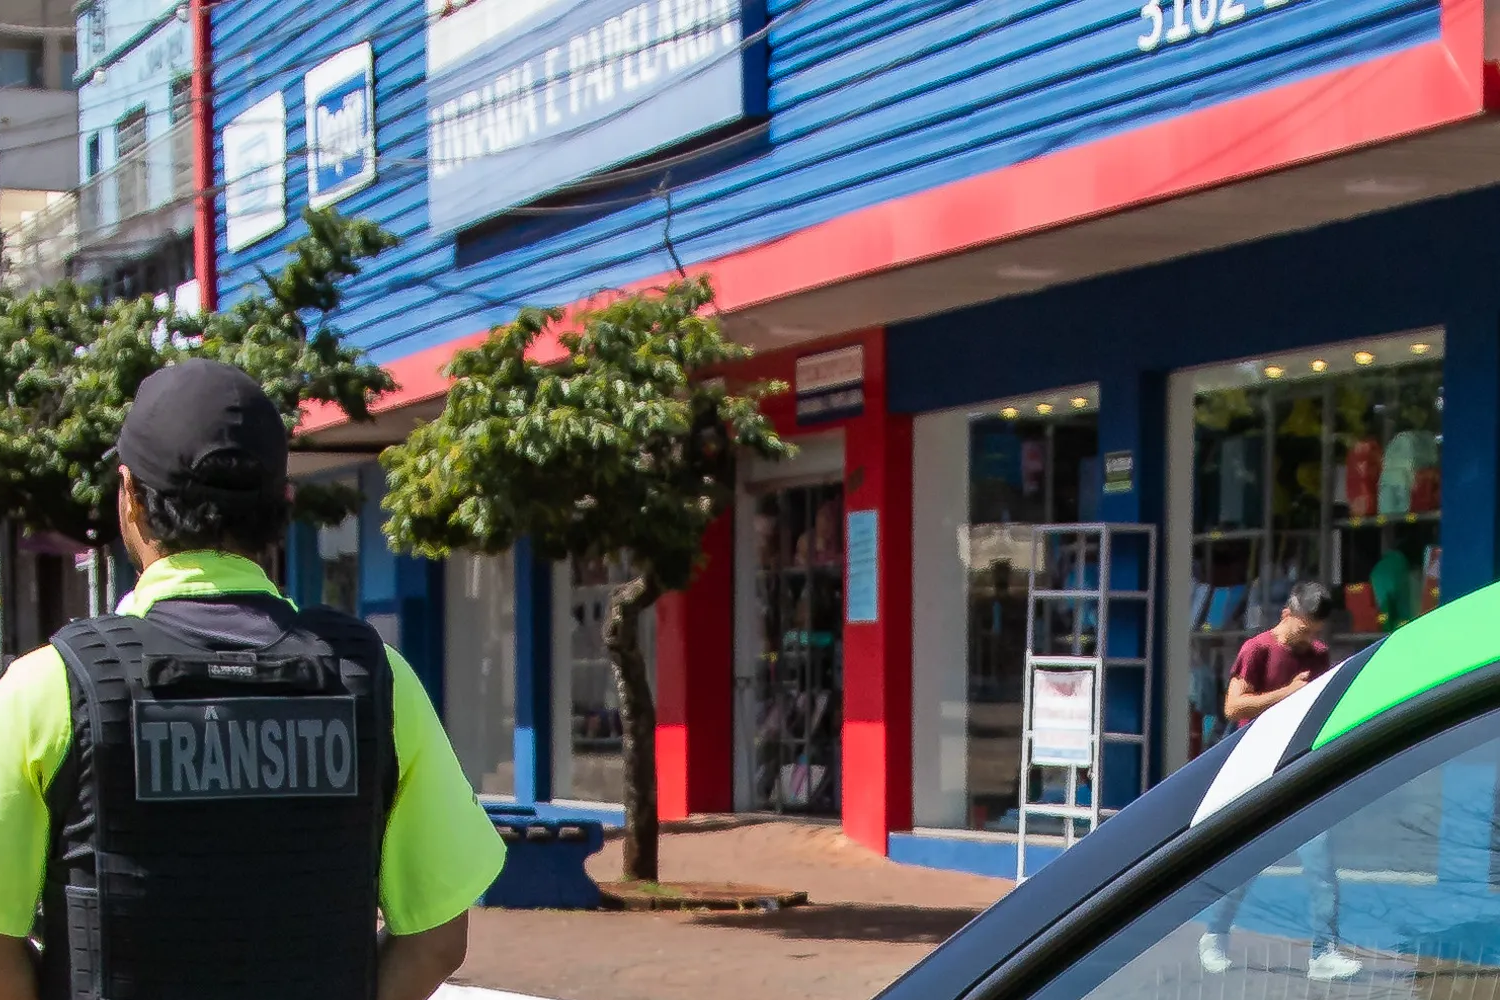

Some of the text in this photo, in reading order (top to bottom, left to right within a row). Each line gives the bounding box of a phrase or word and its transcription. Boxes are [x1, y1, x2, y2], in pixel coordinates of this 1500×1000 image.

[430, 61, 537, 179] LIVRARIA
[544, 46, 562, 126] E
[568, 0, 735, 116] PAPELARIA
[141, 705, 350, 792] TRÂNSITO
